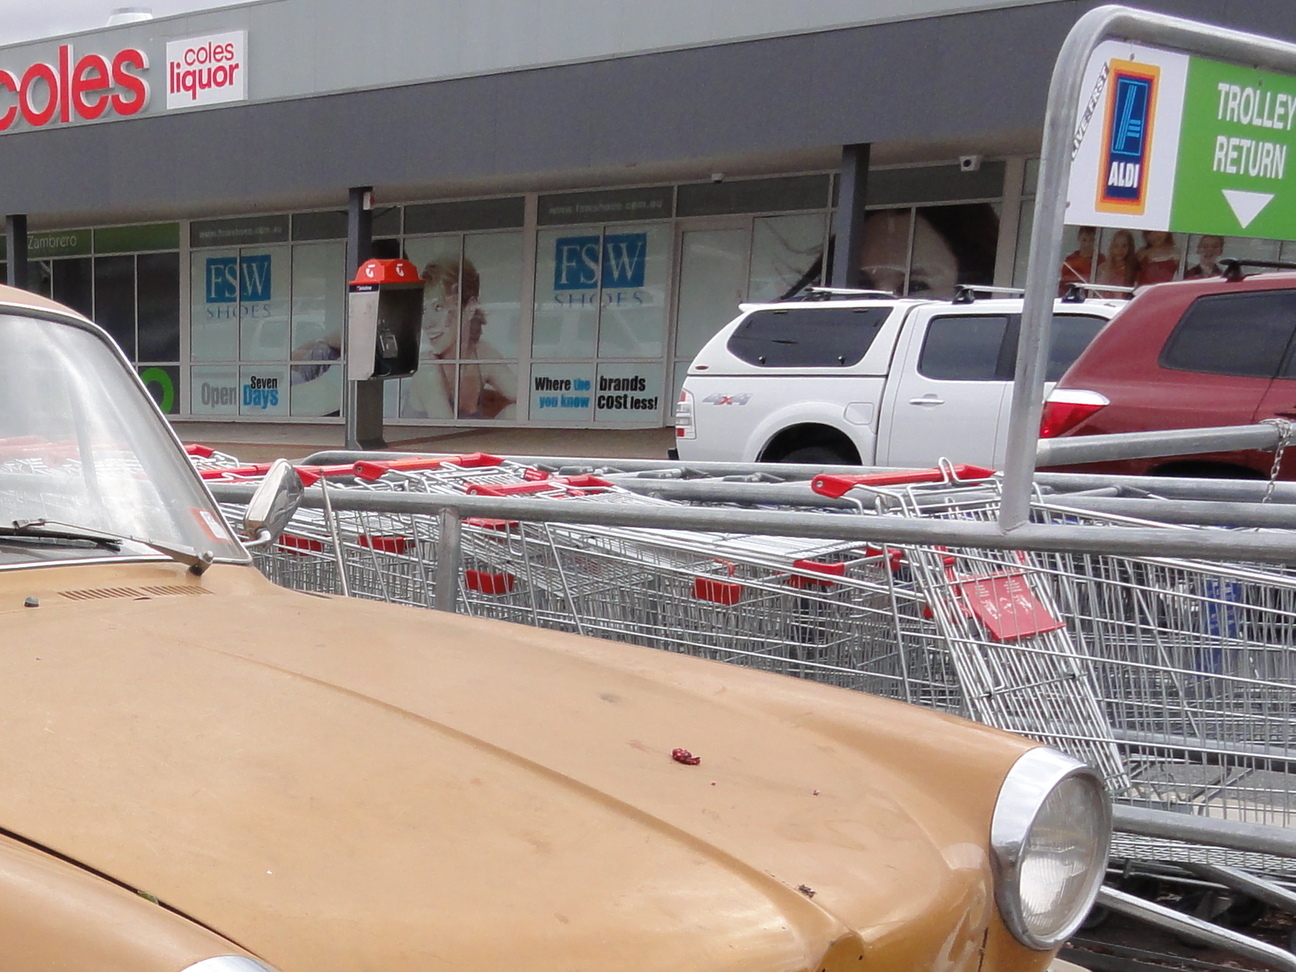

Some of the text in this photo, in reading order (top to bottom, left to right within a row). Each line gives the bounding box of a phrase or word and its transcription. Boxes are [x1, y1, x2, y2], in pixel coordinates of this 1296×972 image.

[184, 41, 234, 66] coles
[169, 61, 239, 100] liquor
[1217, 82, 1296, 131] TROLLEY
[1213, 135, 1287, 179] RETURN
[1107, 161, 1140, 188] ALDI
[27, 234, 77, 250] Zambrero
[560, 242, 642, 284] FSW
[210, 262, 268, 298] FSW
[206, 304, 272, 319] SHOES
[554, 290, 644, 308] SHOES
[201, 376, 279, 409] Open Seven Days
[535, 375, 646, 392] Where the brands
[539, 394, 658, 410] you know cost less!
